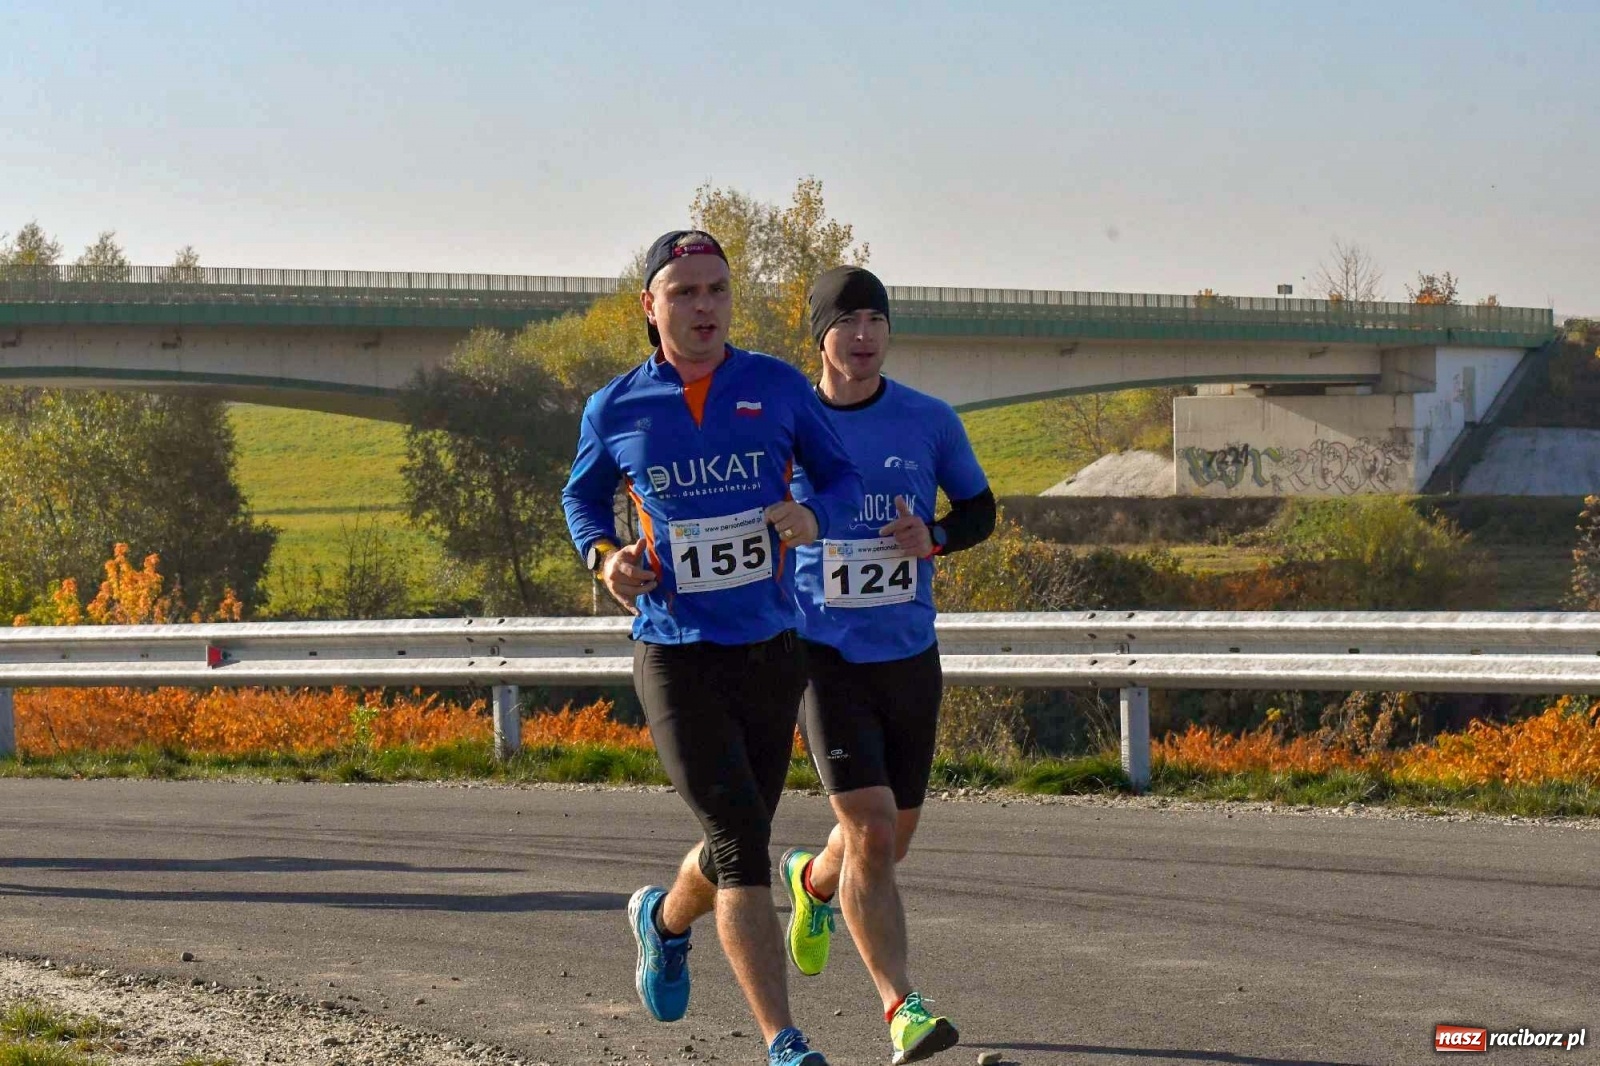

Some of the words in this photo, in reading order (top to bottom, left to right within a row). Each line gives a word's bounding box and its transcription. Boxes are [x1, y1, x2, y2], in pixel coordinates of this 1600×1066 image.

[647, 451, 765, 492] DUKAT
[681, 535, 766, 578] 155
[831, 560, 913, 595] 124
